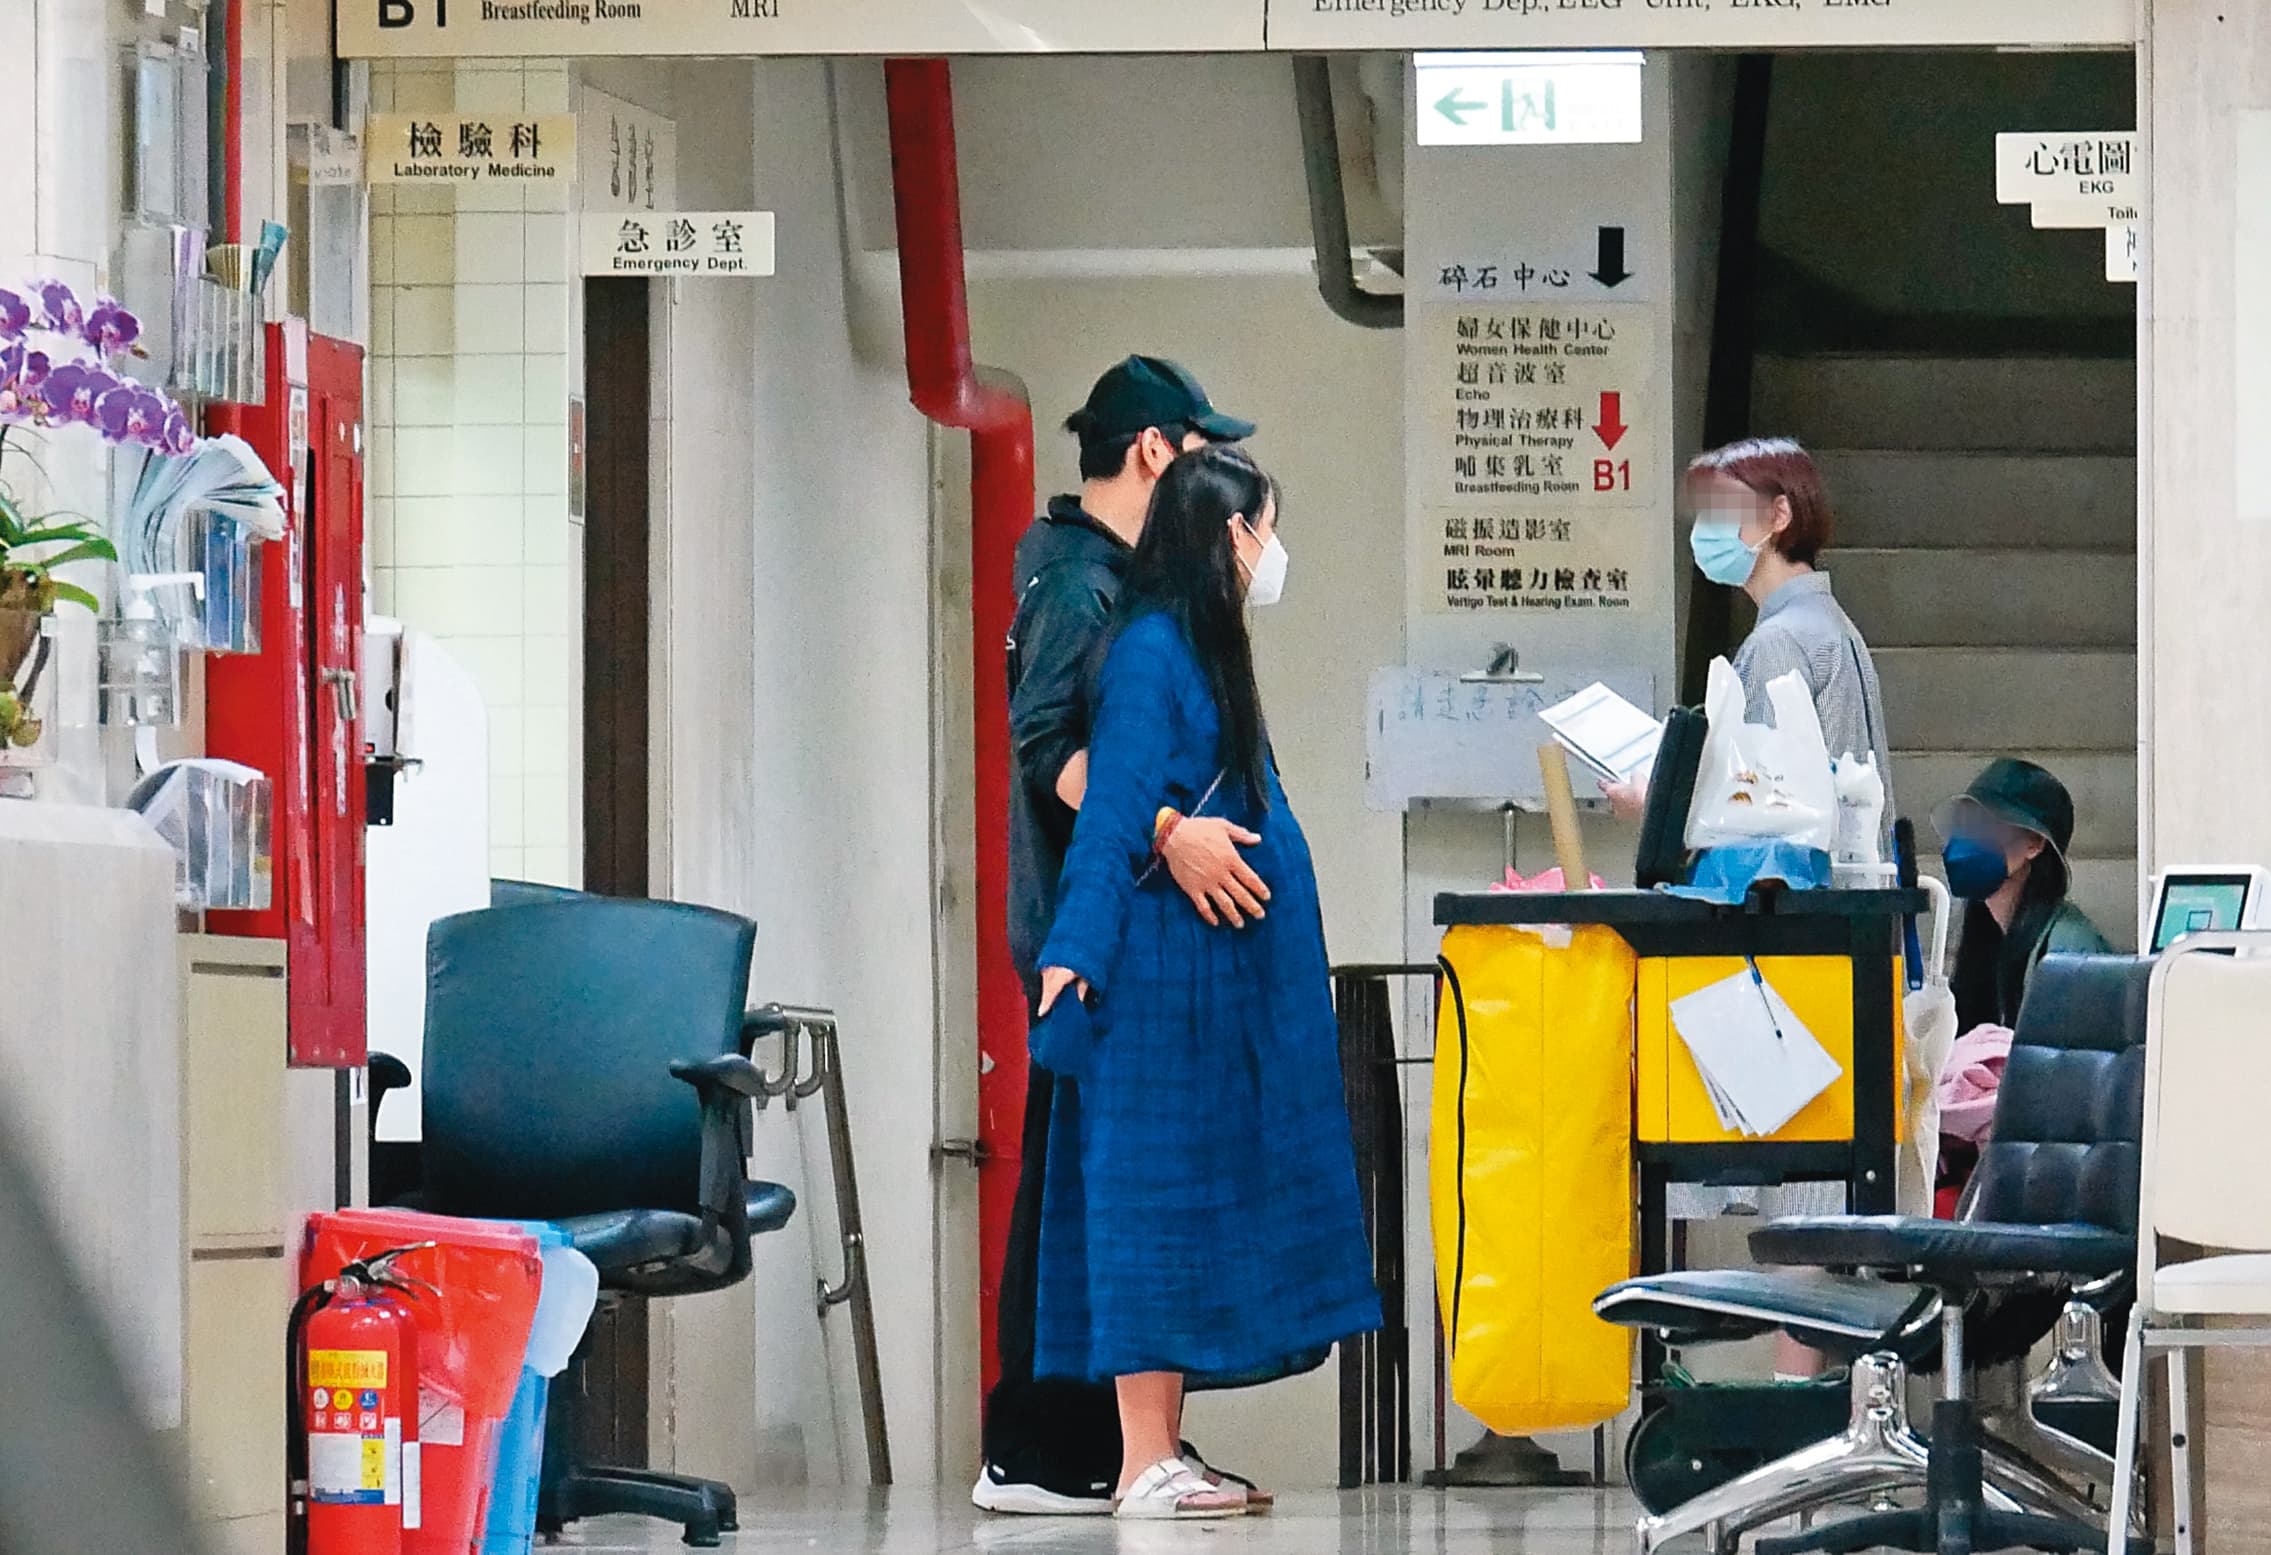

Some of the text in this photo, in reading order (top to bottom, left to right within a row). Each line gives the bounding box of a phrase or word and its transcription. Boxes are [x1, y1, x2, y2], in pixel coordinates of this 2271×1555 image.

[481, 0, 641, 25] Breastfeeding Room
[730, 0, 779, 19] MRI
[409, 121, 542, 159] 檢驗科
[2025, 140, 2137, 175] 心電圖
[393, 162, 556, 181] Laboratory Medicine
[2079, 180, 2115, 194] EKG
[617, 218, 744, 253] 急診室
[612, 256, 748, 273] Emergency Dept.
[1438, 261, 1571, 293] 碎石中心
[1456, 315, 1616, 341] 婦女保健中心
[1456, 342, 1609, 357] Women Health Center
[1457, 360, 1566, 385] 超音波室
[1455, 387, 1491, 401] Echo
[1455, 406, 1583, 431] 物理治療科
[1455, 432, 1574, 450] Physical Therapy
[1454, 479, 1580, 496] Breastfeeding Room
[1593, 458, 1630, 492] B1
[1445, 517, 1571, 542] 磁振造影室
[1443, 543, 1516, 558] MRI Room
[1447, 567, 1628, 592] 眩暈聽力檢查室
[1446, 594, 1630, 610] Vertigo Test & Hearing Exam. Room
